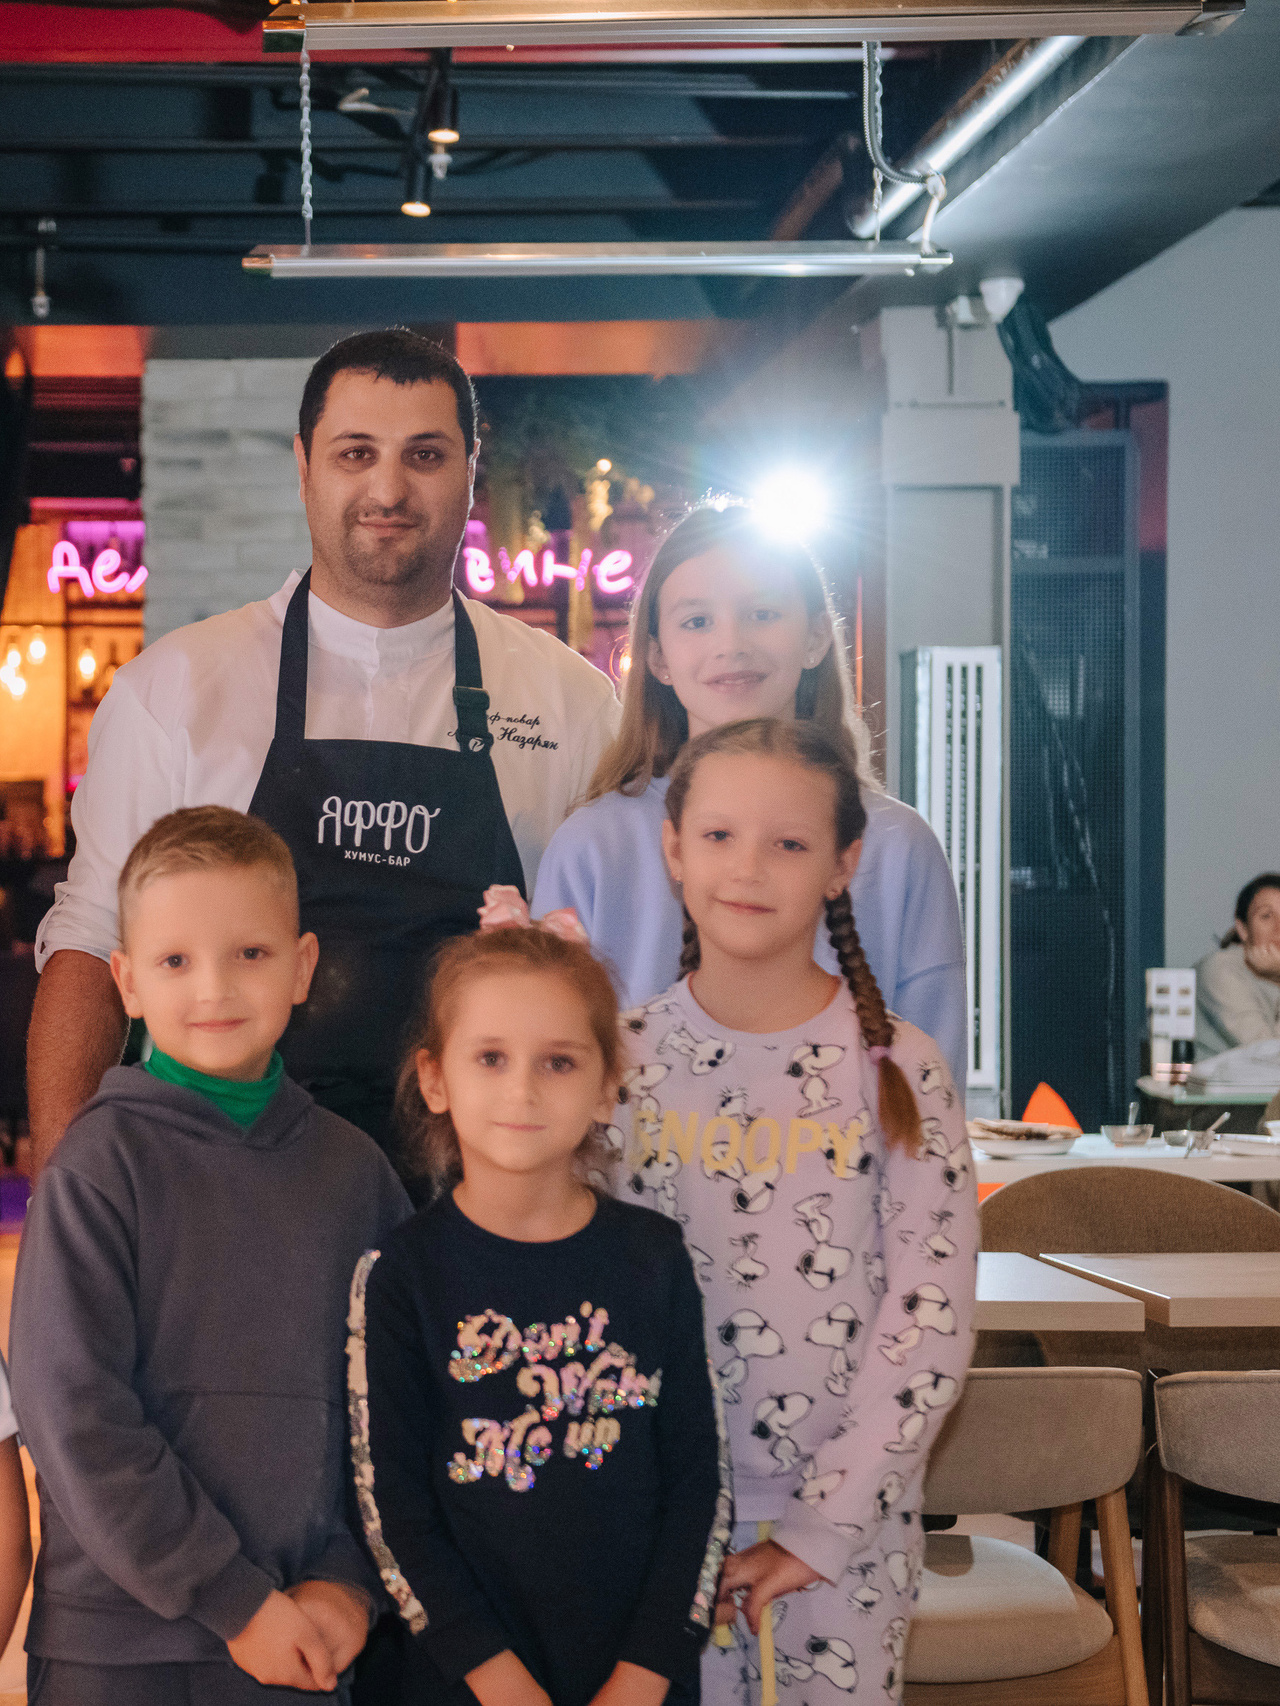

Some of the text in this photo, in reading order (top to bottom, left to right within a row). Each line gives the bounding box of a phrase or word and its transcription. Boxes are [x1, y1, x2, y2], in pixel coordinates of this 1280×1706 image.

[486, 711, 540, 730] ф-повар
[497, 727, 559, 751] Назарян
[318, 795, 441, 854] ЯФФО
[344, 849, 411, 867] ХУМУС-БАР
